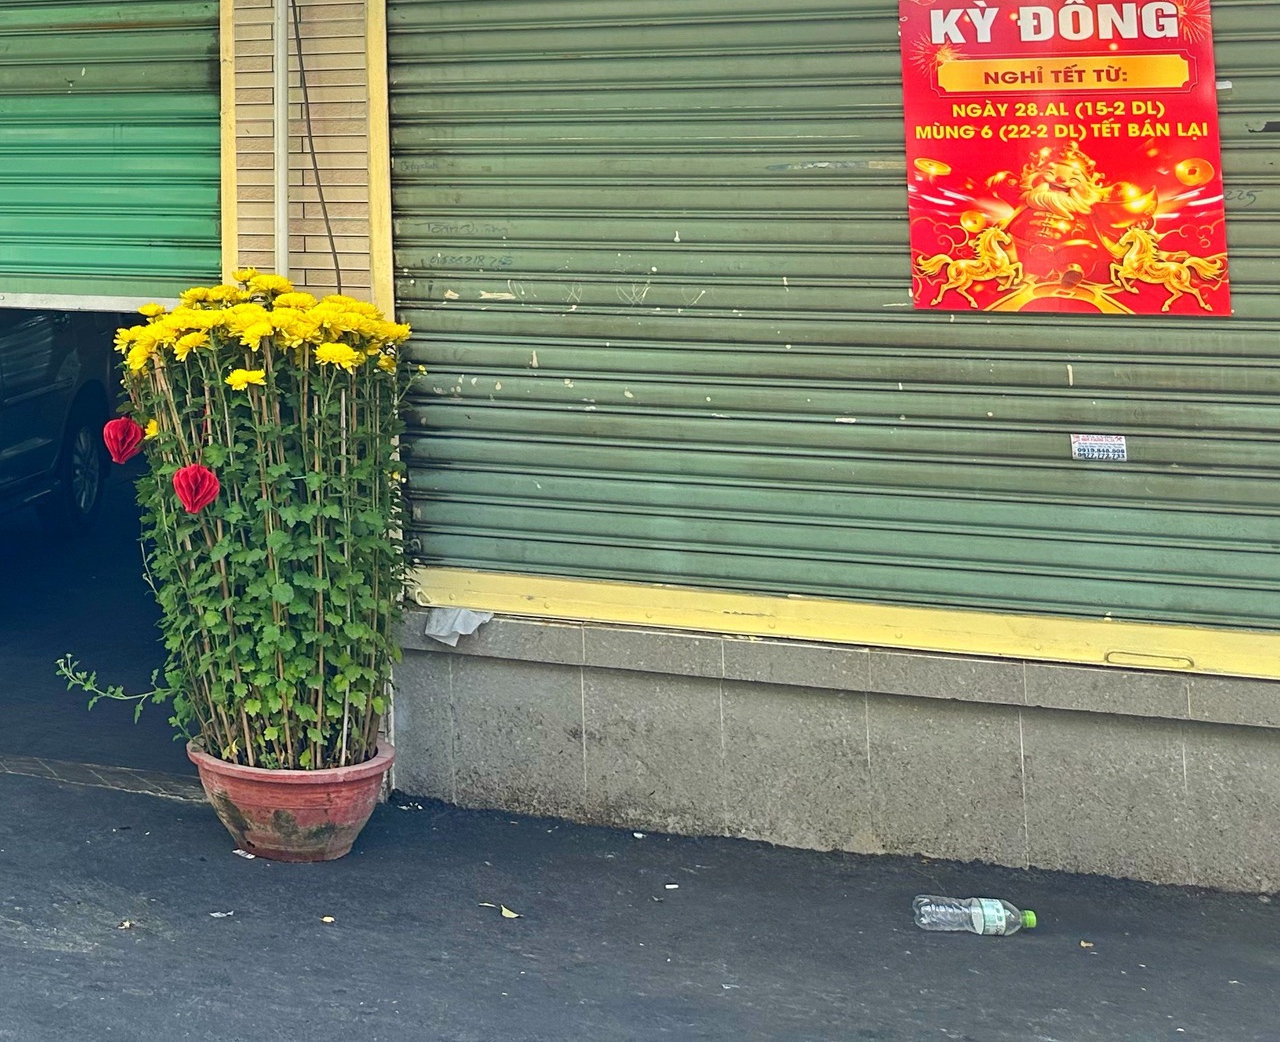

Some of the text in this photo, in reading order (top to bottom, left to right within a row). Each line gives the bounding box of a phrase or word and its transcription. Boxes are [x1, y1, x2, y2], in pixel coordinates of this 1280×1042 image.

[930, 0, 999, 45] KỲ
[983, 63, 1128, 86] NGHỈ TẾT TỪ:
[952, 100, 1165, 120] NGÀY 28.AL (15-2 DL)
[915, 118, 1208, 142] MÙNG 6 (22-2 DL) TẾT BÁN LẠI
